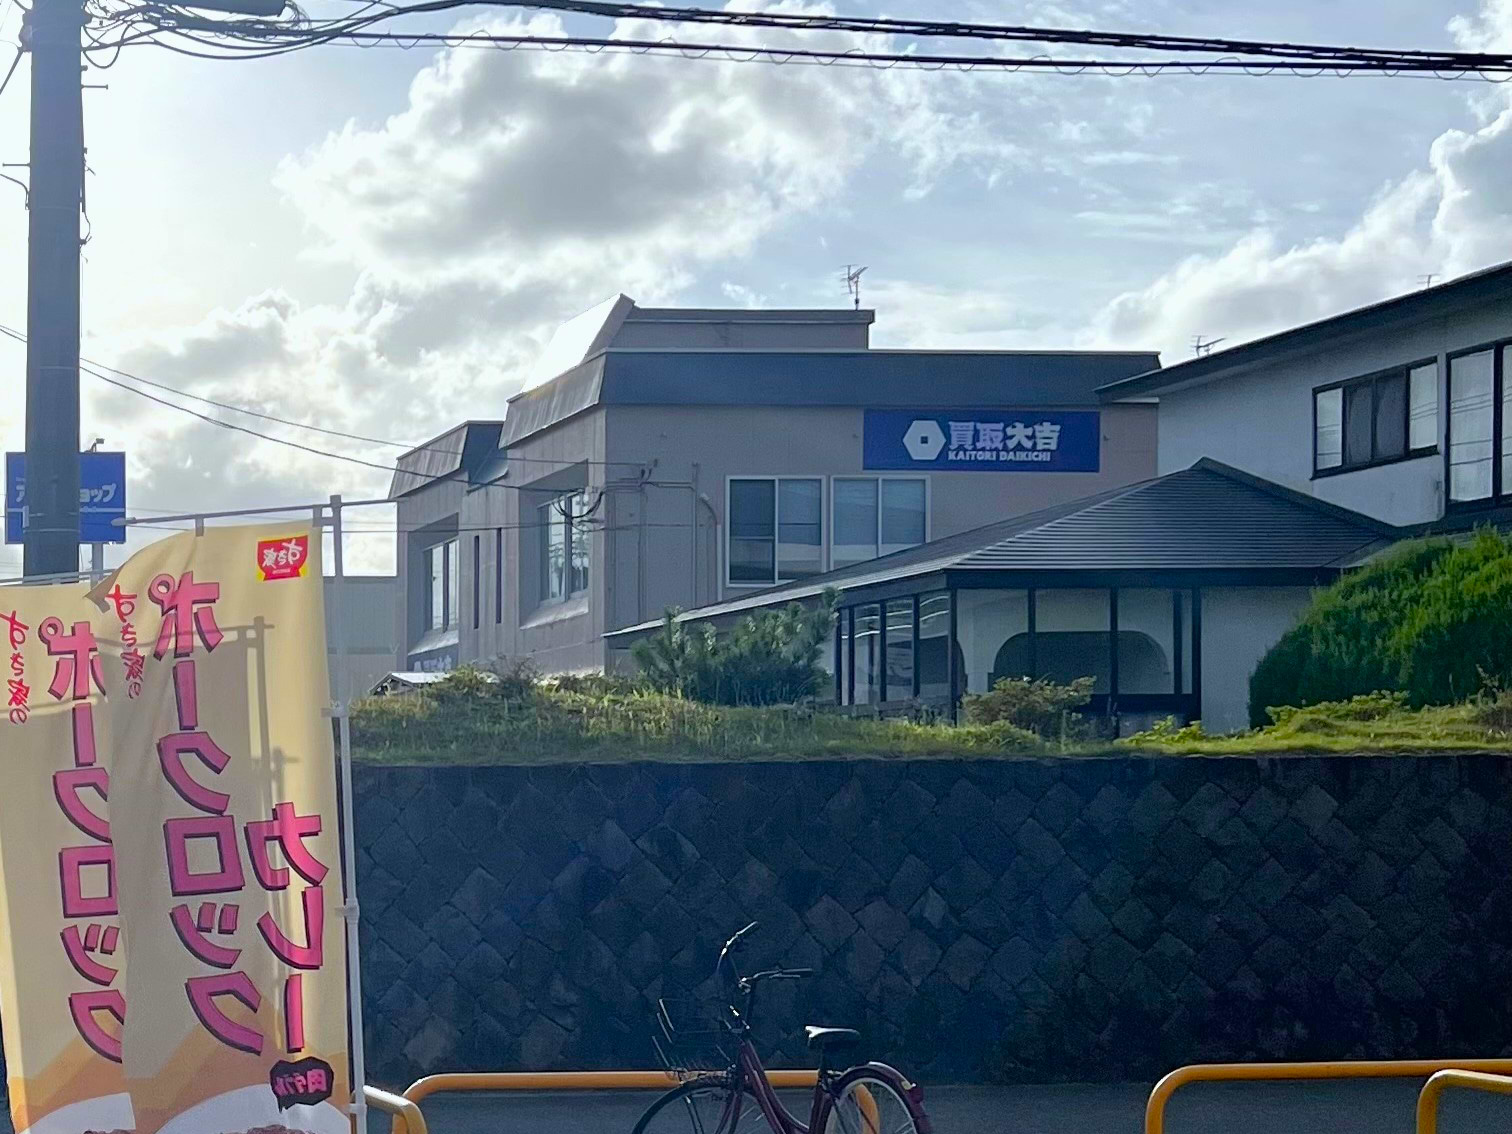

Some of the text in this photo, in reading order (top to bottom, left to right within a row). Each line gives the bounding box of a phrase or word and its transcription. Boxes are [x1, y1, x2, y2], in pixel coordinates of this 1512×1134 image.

[948, 421, 1061, 450] 買取大吉
[948, 451, 1051, 462] KAITORI DAIKICHI
